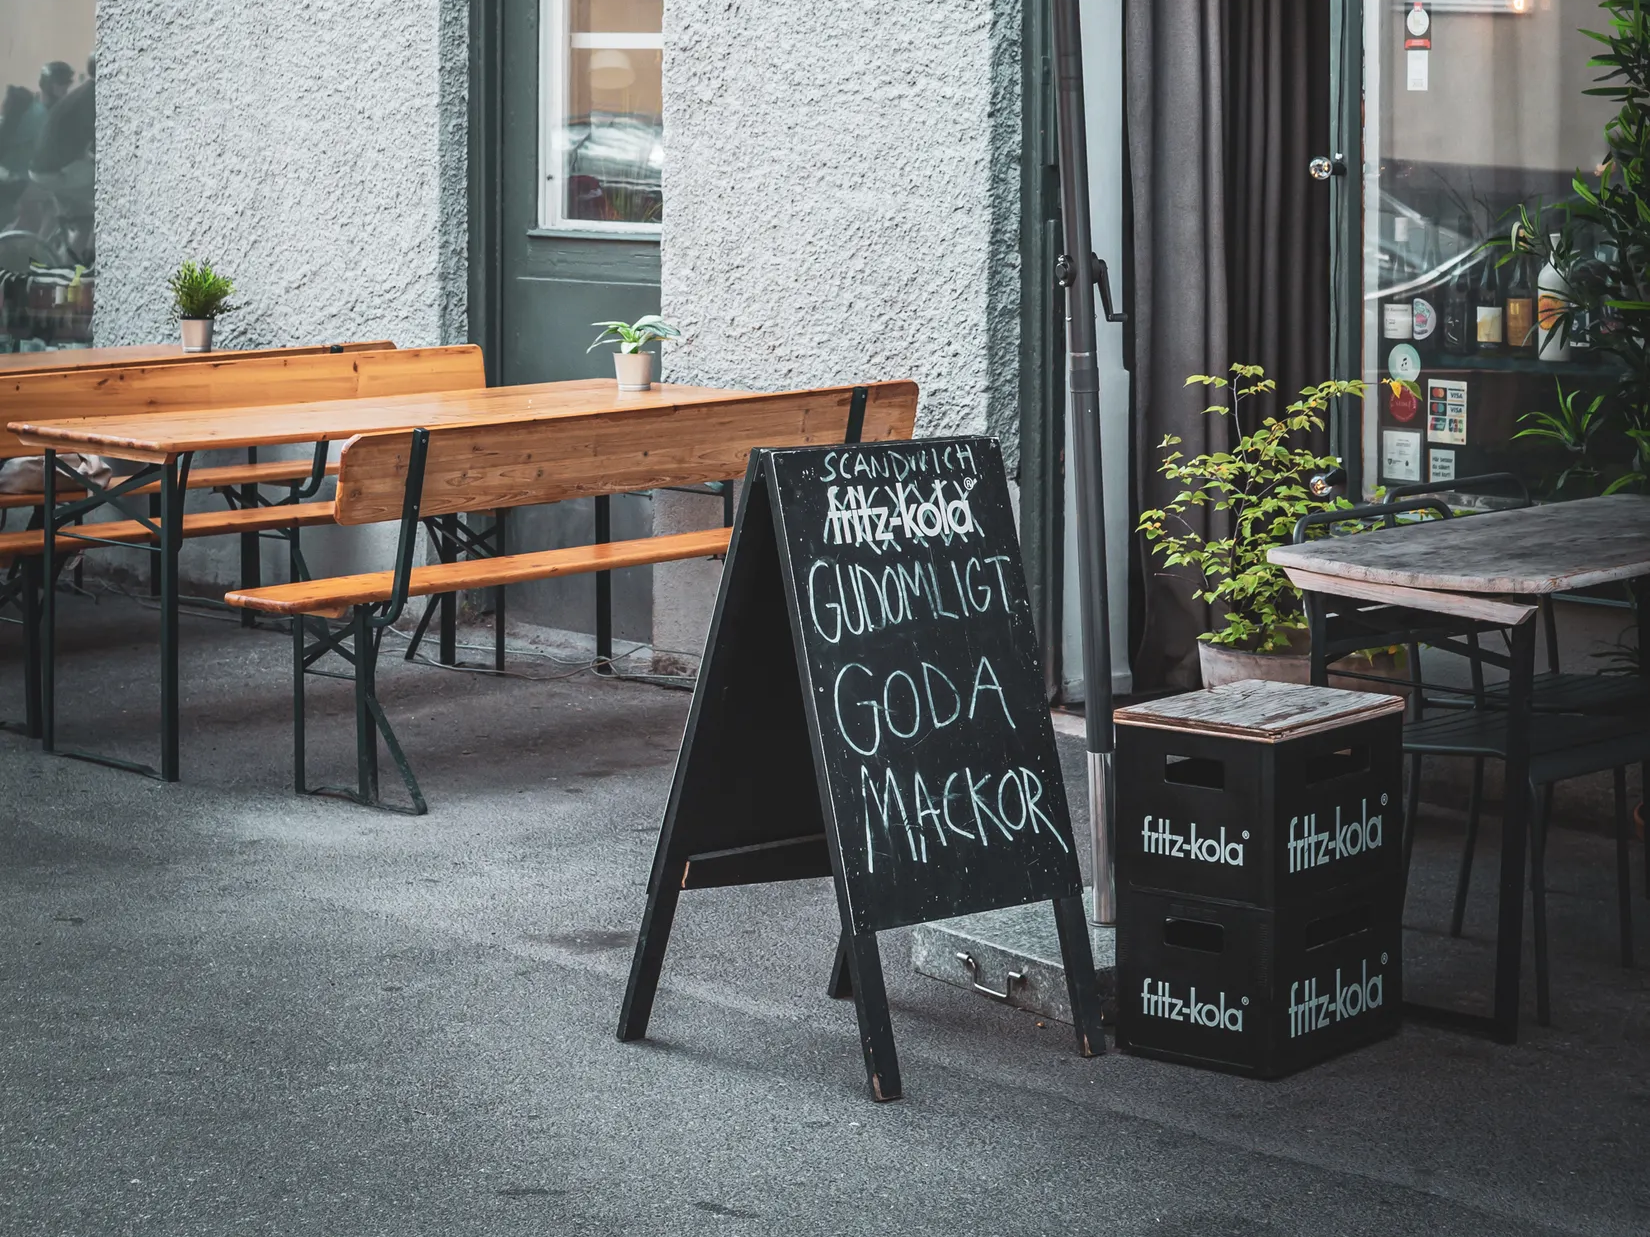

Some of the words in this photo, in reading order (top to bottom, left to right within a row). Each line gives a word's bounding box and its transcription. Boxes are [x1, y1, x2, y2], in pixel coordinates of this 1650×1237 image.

[820, 444, 978, 482] SCANDWICH
[808, 556, 1012, 643] GUDOMLIGT
[833, 655, 1016, 756] GODA
[861, 764, 1069, 873] MACKOR
